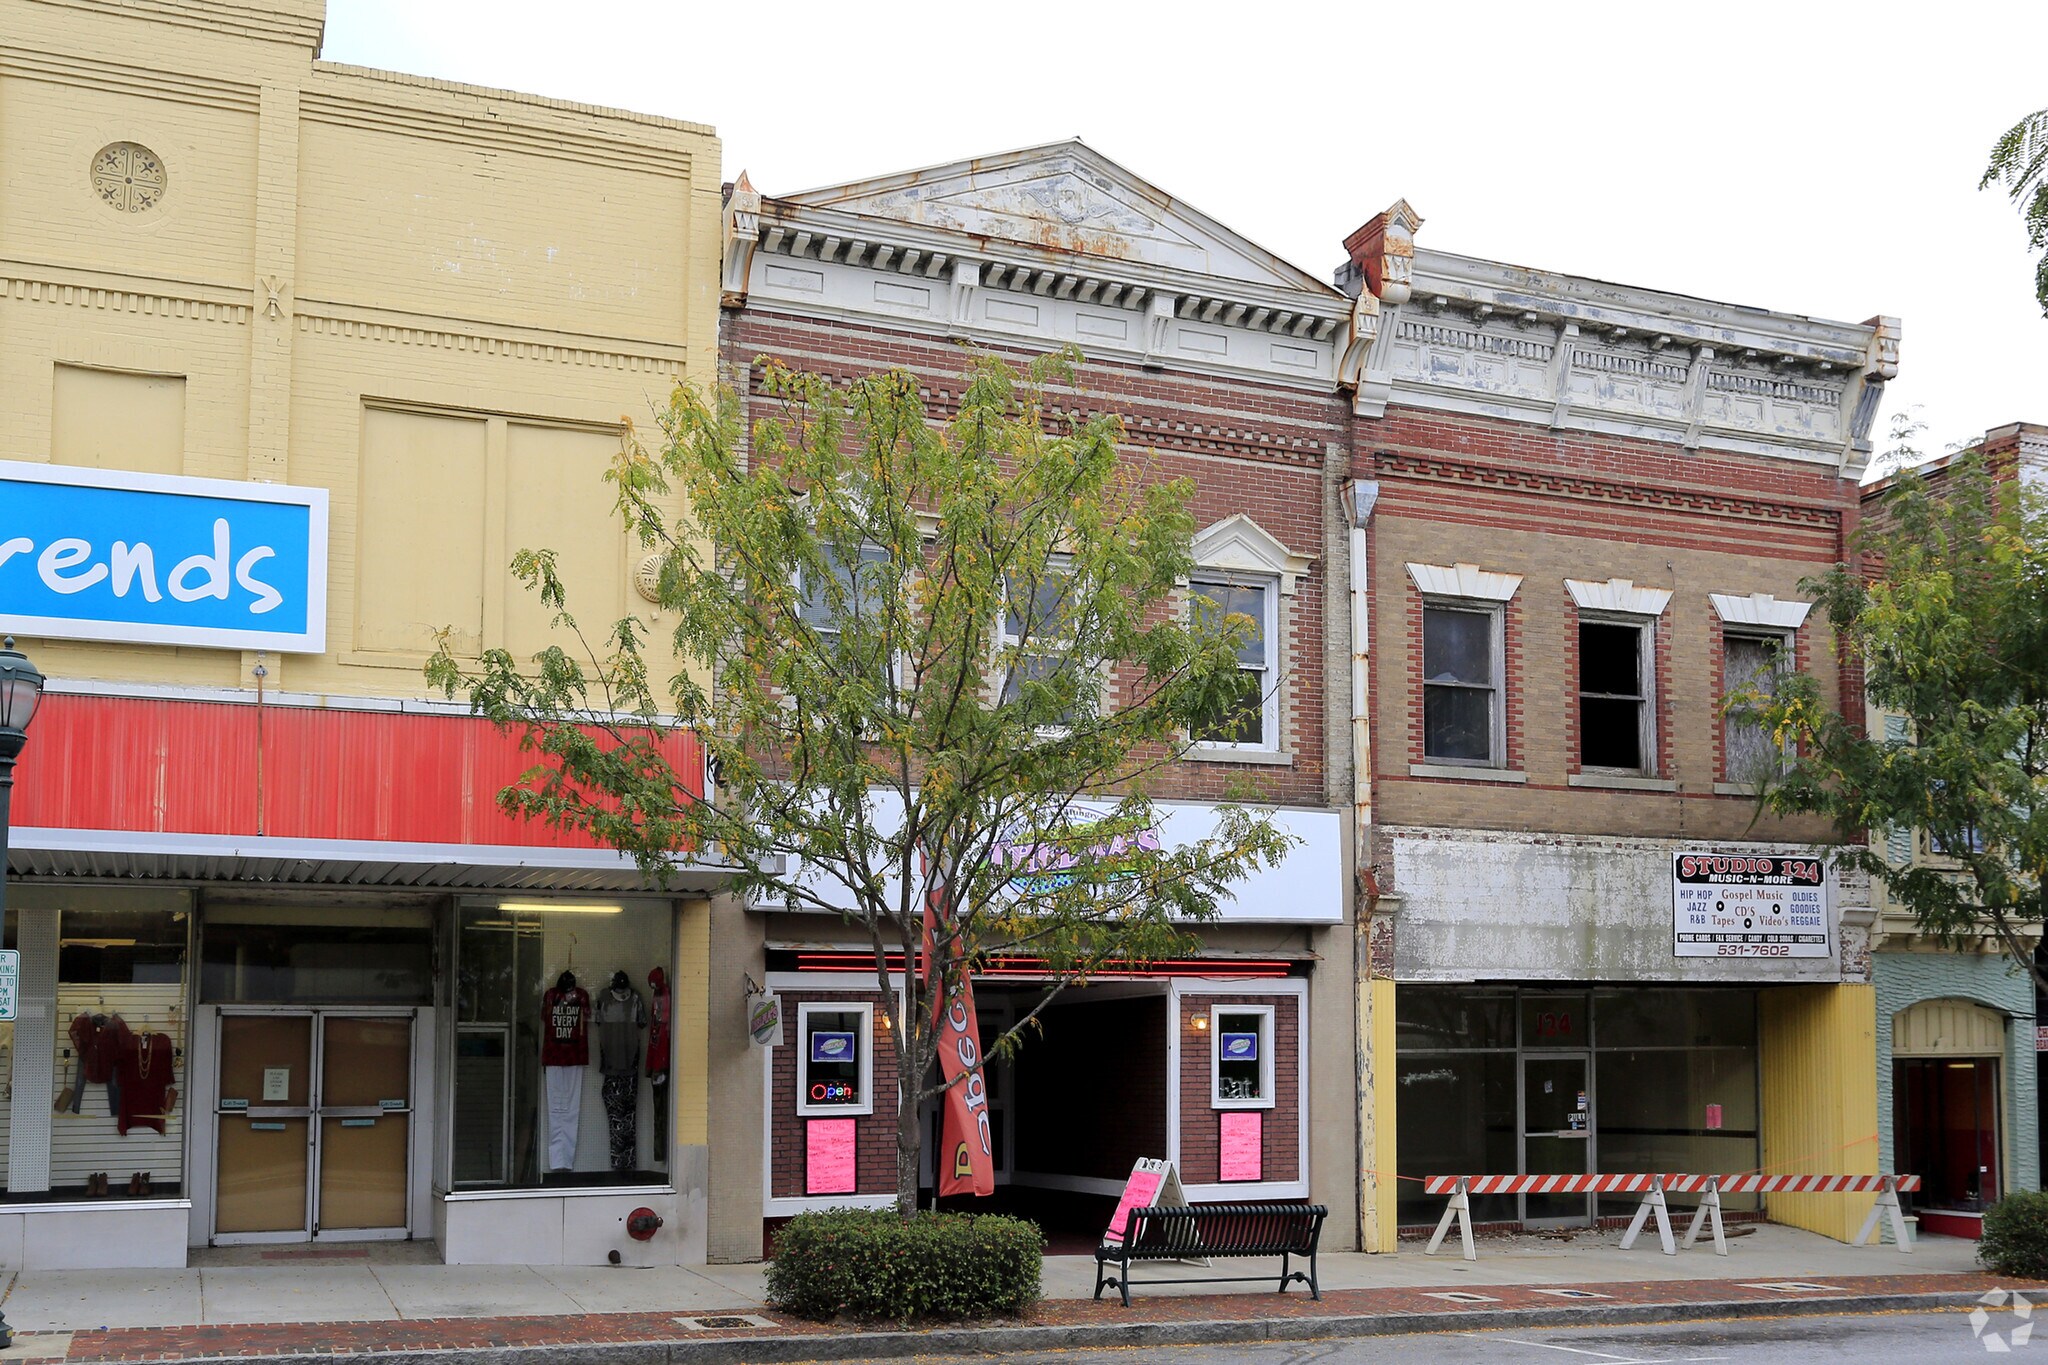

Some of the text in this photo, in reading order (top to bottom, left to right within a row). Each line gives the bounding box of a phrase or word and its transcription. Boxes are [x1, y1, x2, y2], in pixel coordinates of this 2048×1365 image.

[1682, 856, 1819, 883] STUDIO 124
[1709, 873, 1794, 885] MUSIC-N-MORE
[1680, 889, 1713, 900] HIP HOP
[1721, 888, 1784, 902] Gospel Music
[1792, 891, 1818, 902] OLDIES
[1686, 902, 1707, 912] JAZZ
[1734, 905, 1755, 917] CD'S
[1790, 903, 1821, 914] GOODIES
[1690, 914, 1706, 924] R&B
[1711, 914, 1735, 927] Tapes
[1759, 915, 1789, 926] Video's
[1790, 916, 1821, 926] REGGAIE
[1717, 944, 1790, 955] 531-7602
[552, 1006, 580, 1015] ALL DAY
[552, 1015, 578, 1026] EVERY
[1537, 1013, 1572, 1037] 124
[556, 1027, 573, 1038] DAY
[811, 1084, 852, 1100] Open
[1569, 1113, 1585, 1121] PULL
